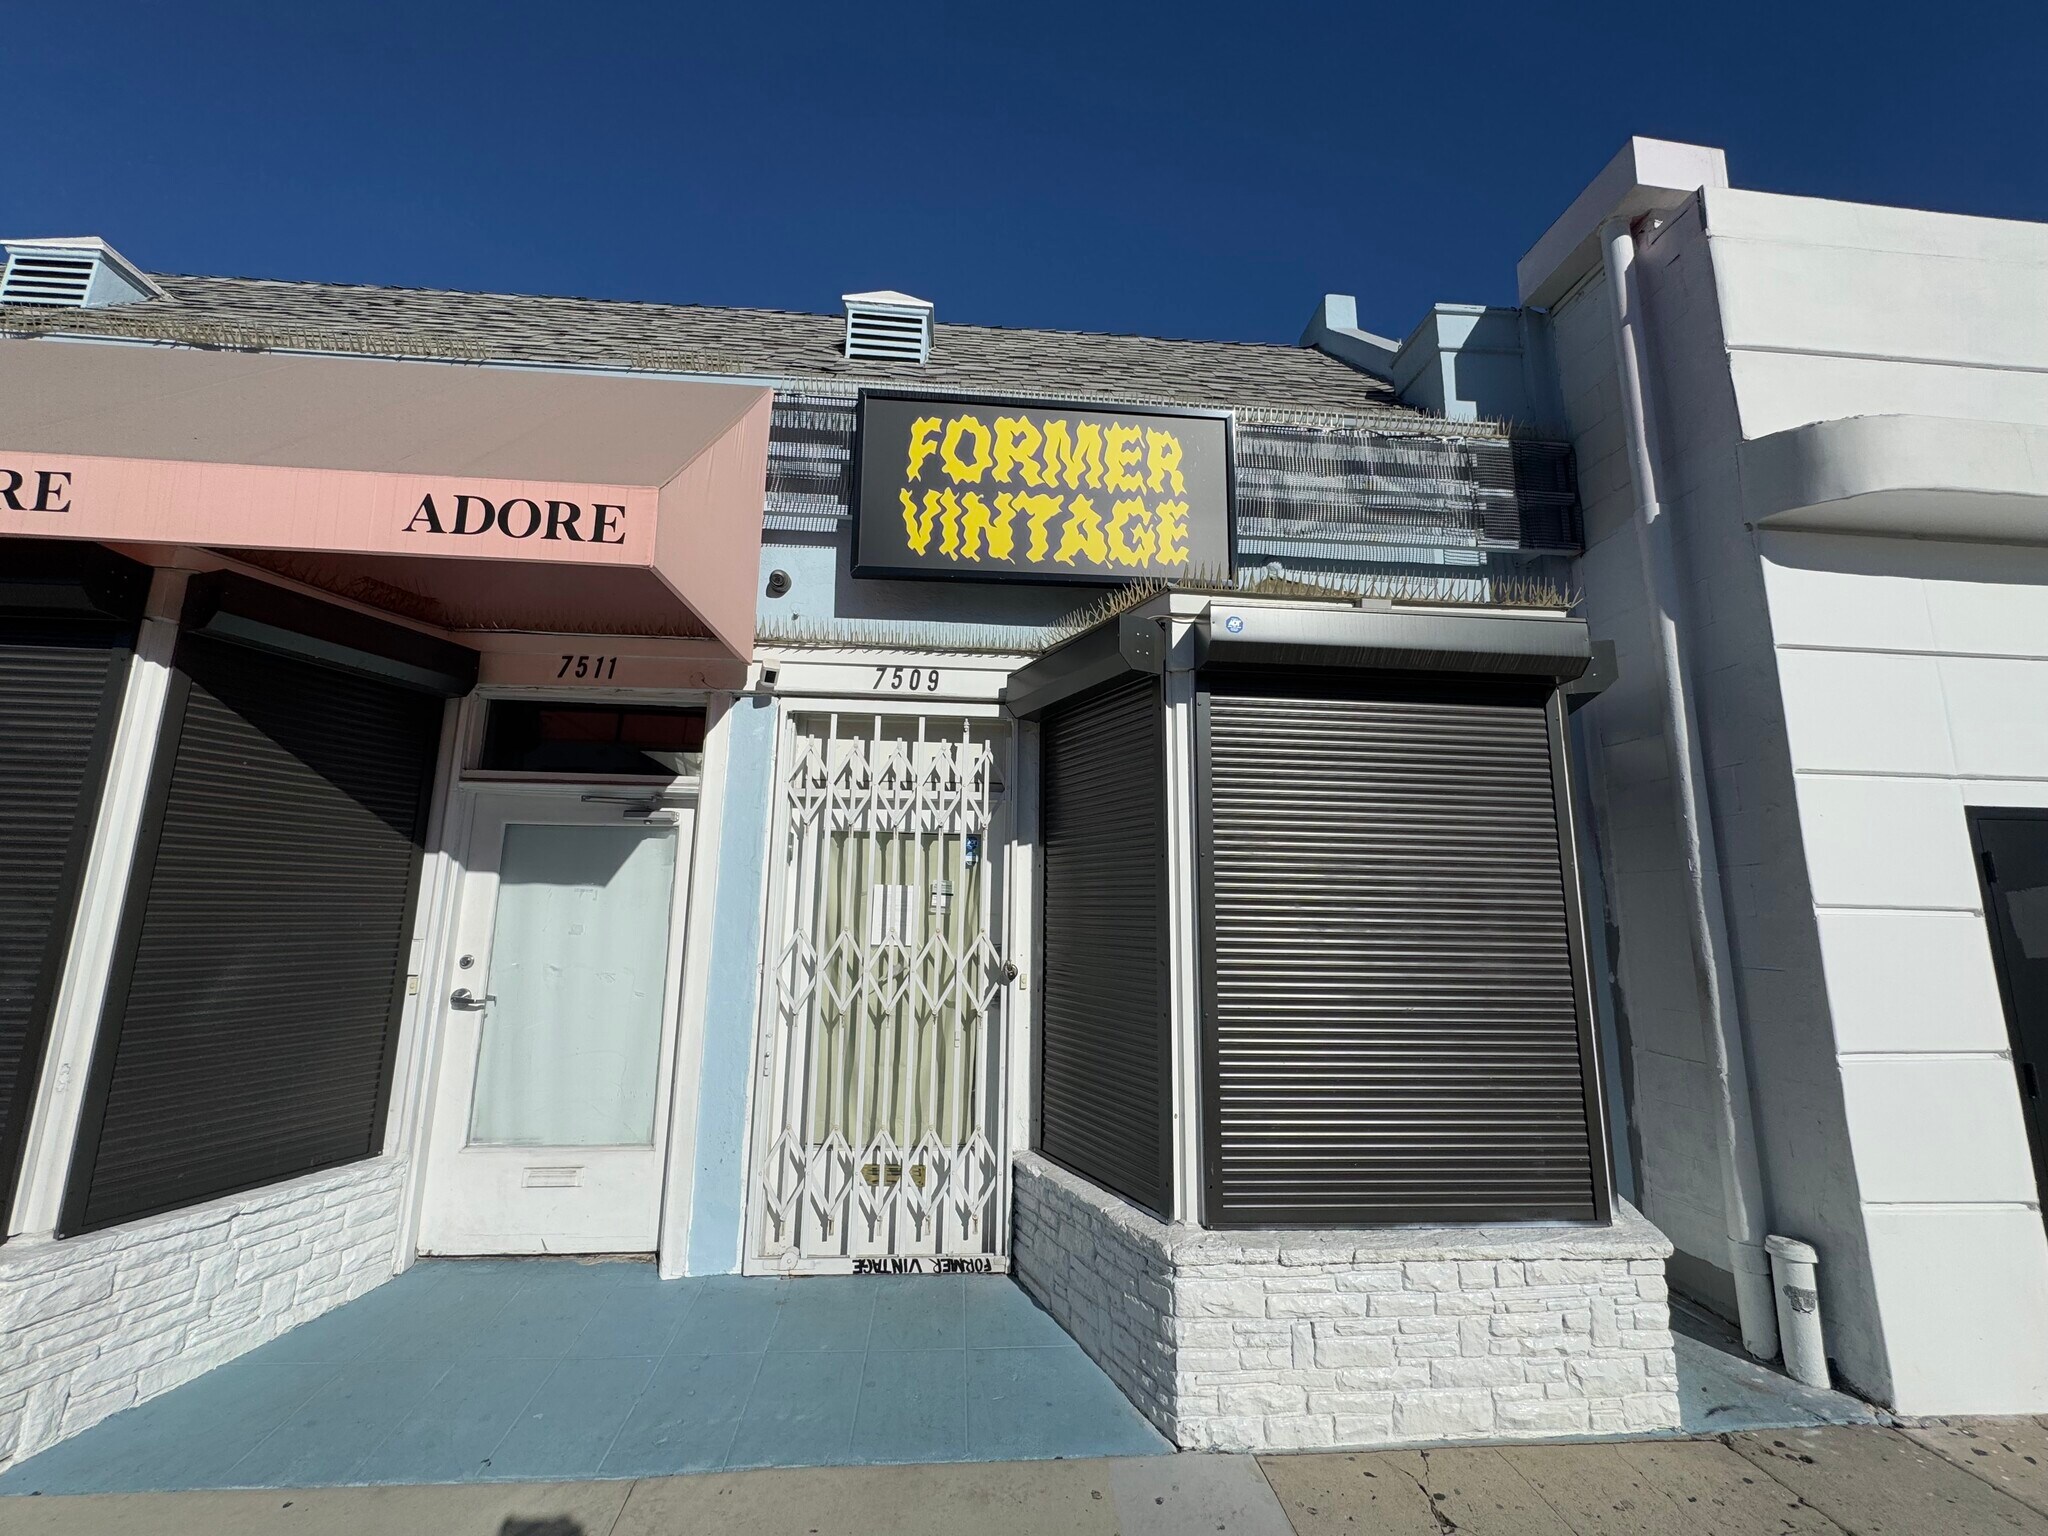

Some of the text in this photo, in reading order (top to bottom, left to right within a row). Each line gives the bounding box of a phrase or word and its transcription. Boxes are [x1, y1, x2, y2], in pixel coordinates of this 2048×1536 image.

[906, 414, 1187, 496] FORMER
[401, 493, 626, 545] ADORE
[899, 487, 1190, 570] VINTAGE
[557, 655, 618, 680] 7511
[872, 667, 940, 692] 7509
[852, 1258, 993, 1274] FORMER VINTAGE
